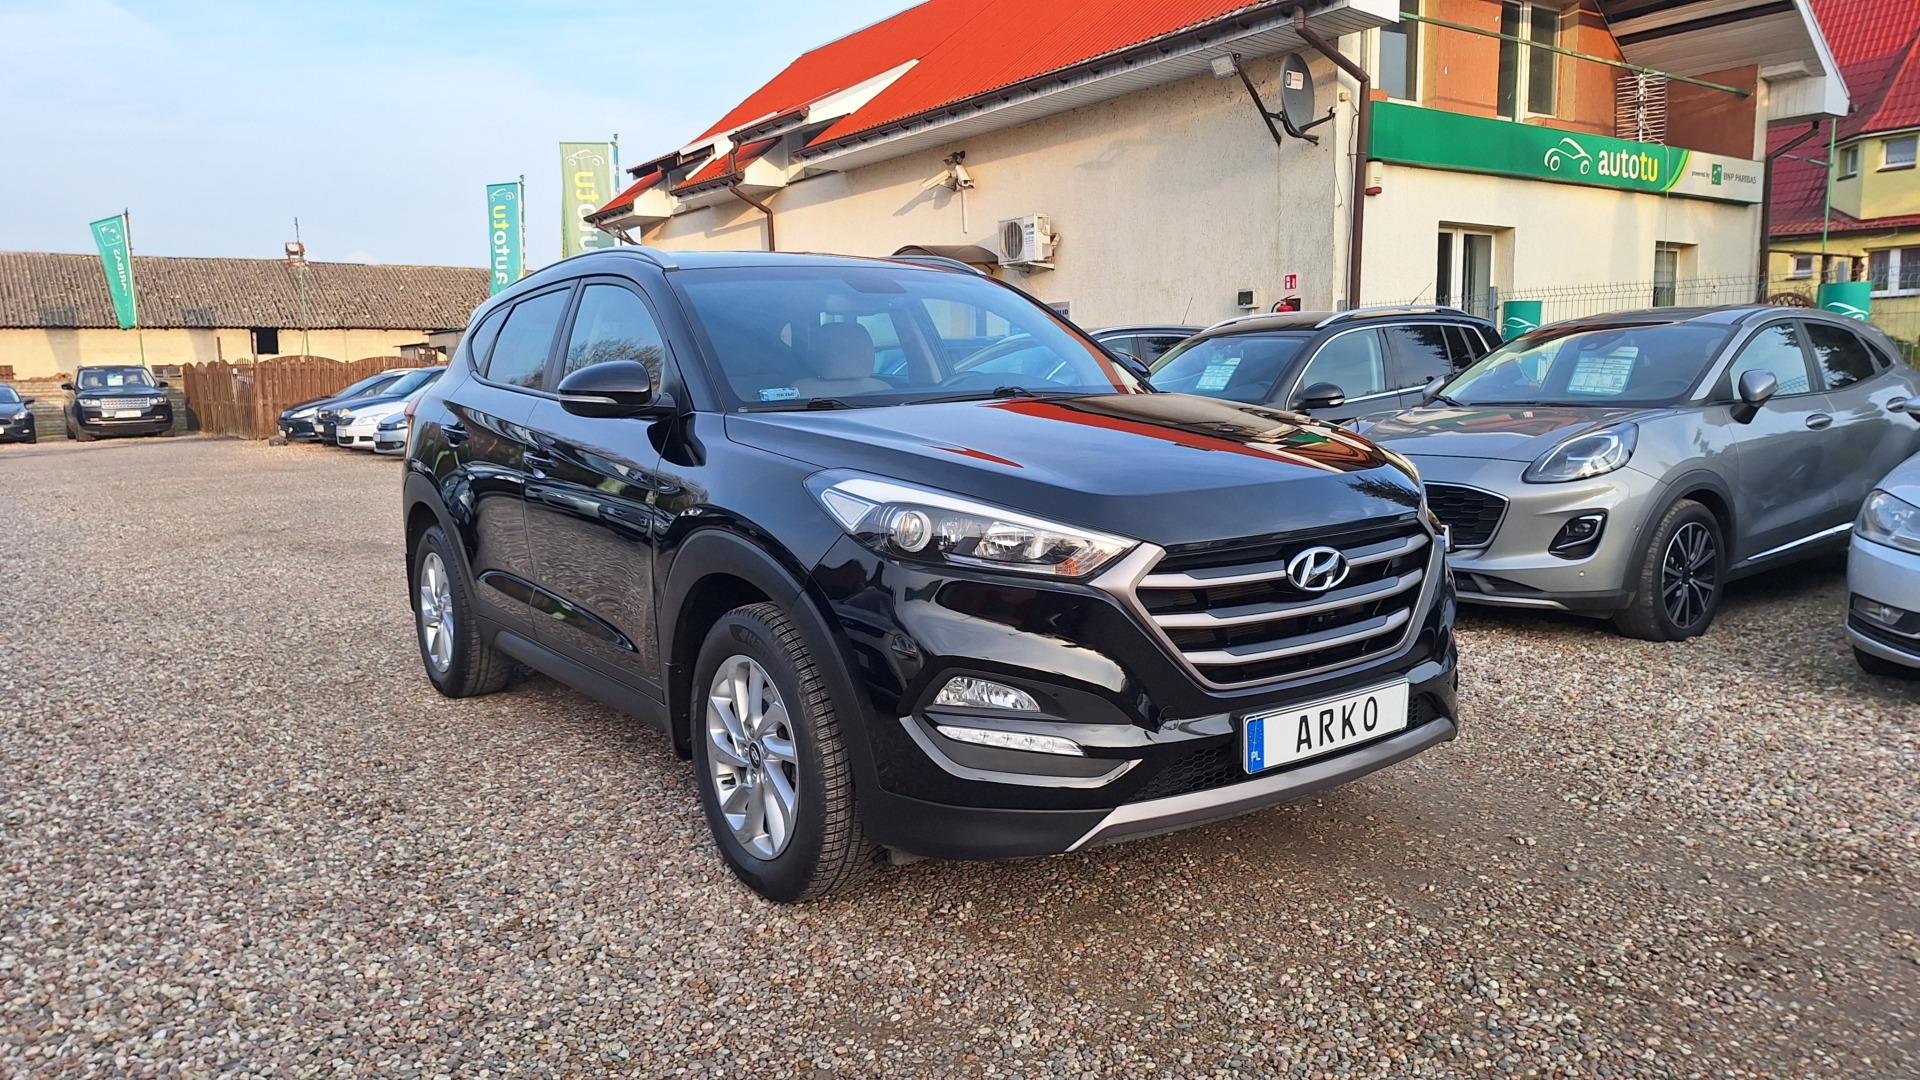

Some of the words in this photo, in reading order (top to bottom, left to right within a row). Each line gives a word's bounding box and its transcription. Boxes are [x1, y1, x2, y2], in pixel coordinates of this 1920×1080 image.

[1598, 148, 1658, 182] autotu
[1723, 172, 1734, 180] BNP
[1735, 174, 1757, 184] PARIBAS
[1296, 696, 1378, 753] ARKO
[1251, 750, 1261, 761] PL
